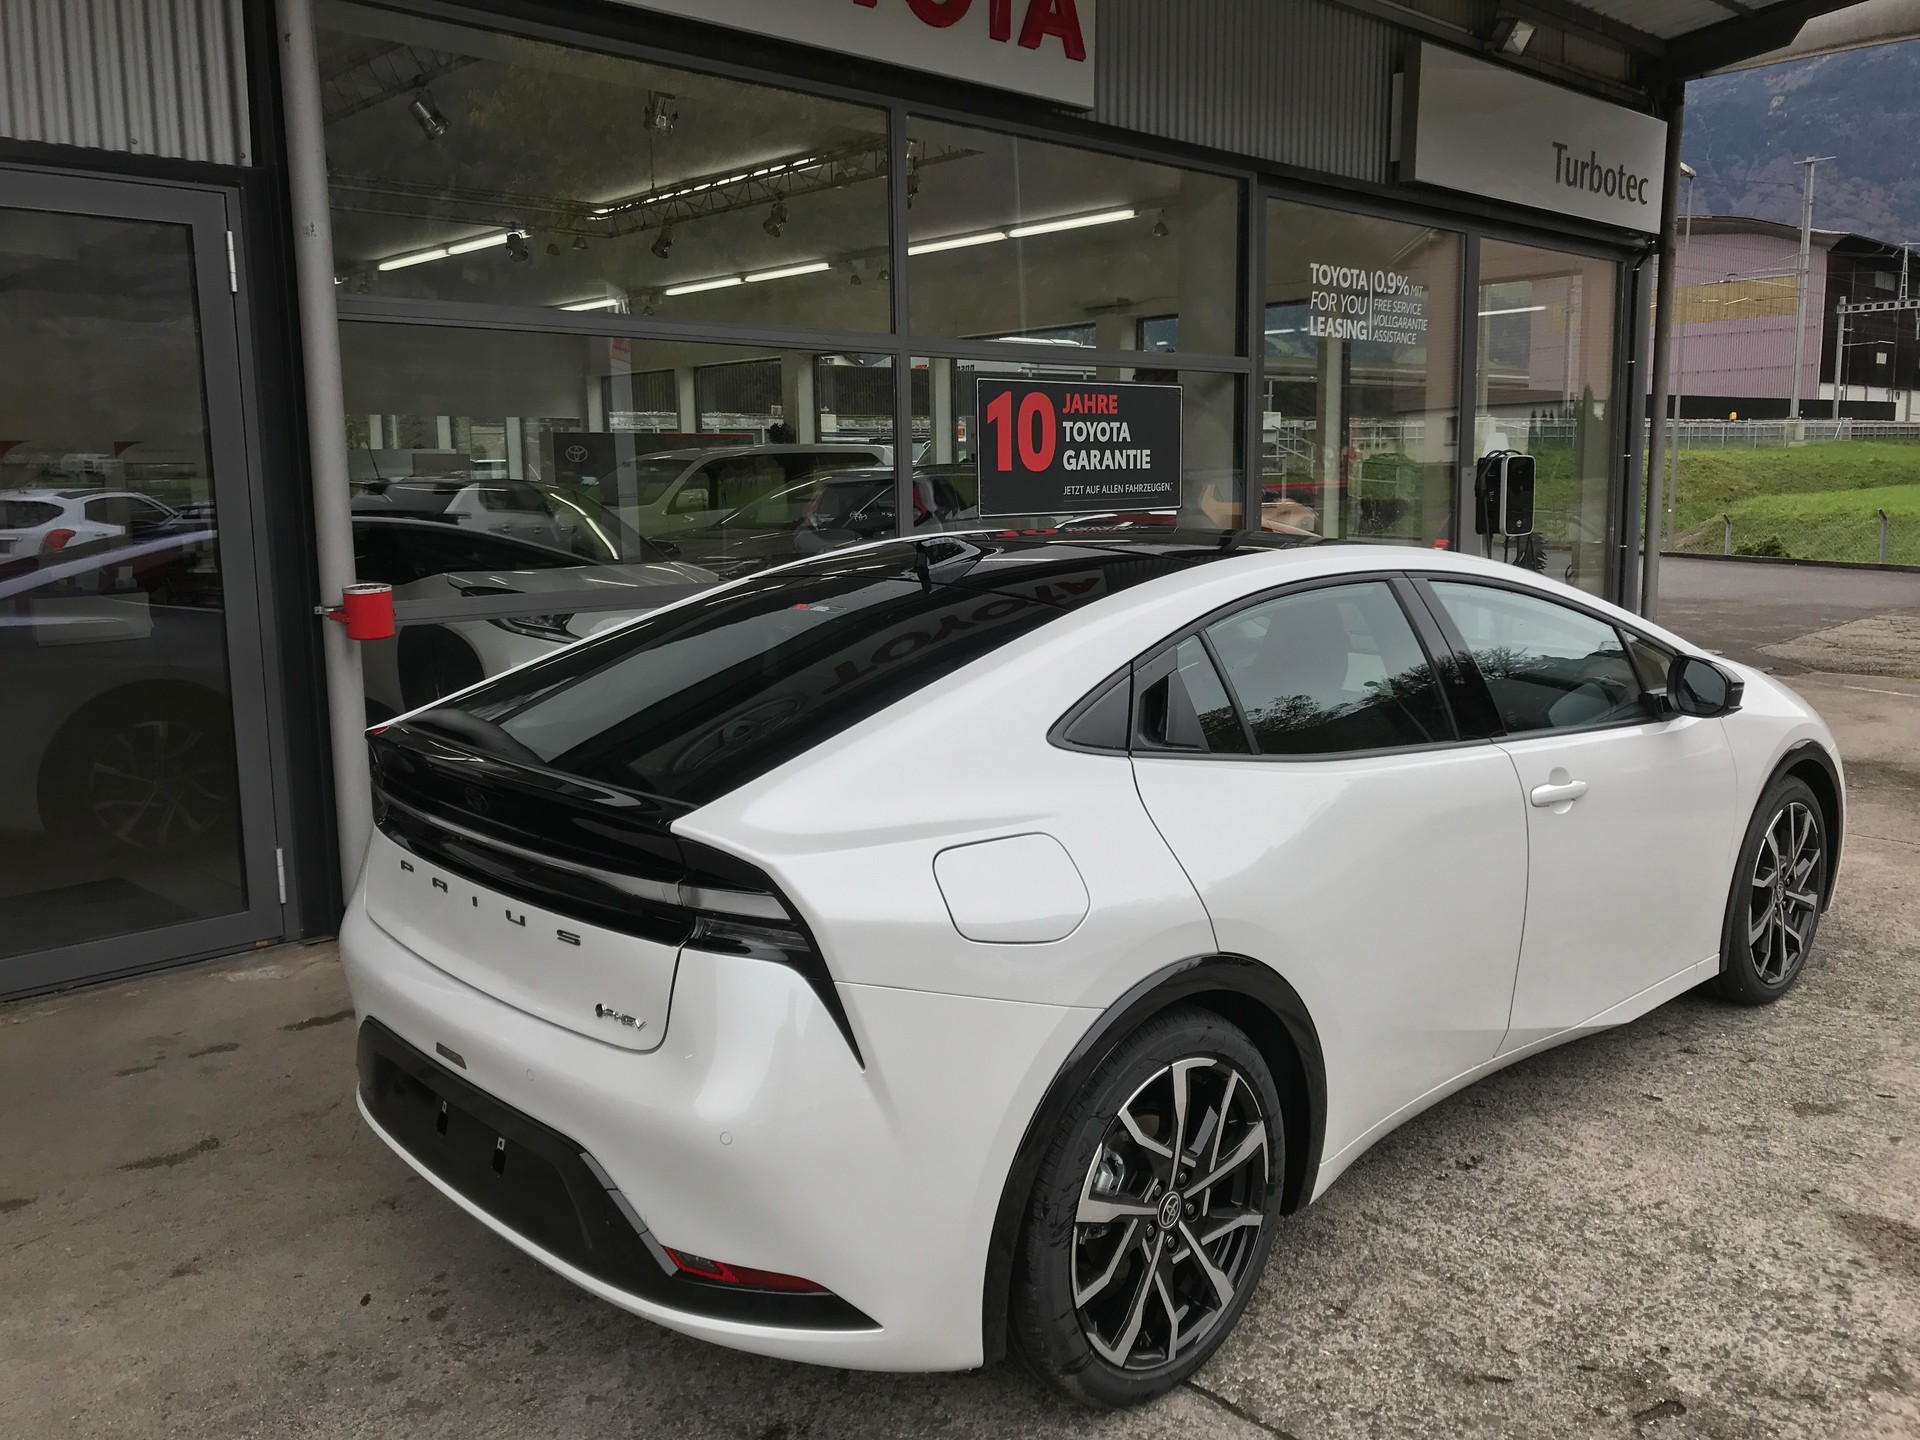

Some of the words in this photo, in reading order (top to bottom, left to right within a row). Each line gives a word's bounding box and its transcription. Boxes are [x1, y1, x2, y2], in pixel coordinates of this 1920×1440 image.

[1552, 141, 1649, 206] Turbotec
[1310, 263, 1368, 291] TOYOTA
[1374, 270, 1410, 296] 0.9%
[1310, 291, 1338, 312] FOR
[1340, 294, 1368, 315] YOU
[1373, 299, 1392, 312] FREE
[1392, 300, 1422, 315] SERVICE
[1309, 316, 1367, 341] LEASING
[1373, 314, 1428, 331] VOLLGARANTIE
[1372, 330, 1417, 345] ASSISTANCE
[1062, 393, 1118, 415] JAHRE
[986, 391, 1057, 472] 10
[1062, 421, 1131, 443] TOYOTA
[1062, 449, 1151, 471] GARANTIE
[1063, 485, 1085, 496] JETZT
[1085, 484, 1101, 495] AUF
[1101, 483, 1124, 494] ALLEN
[400, 860, 581, 946] PRIUS
